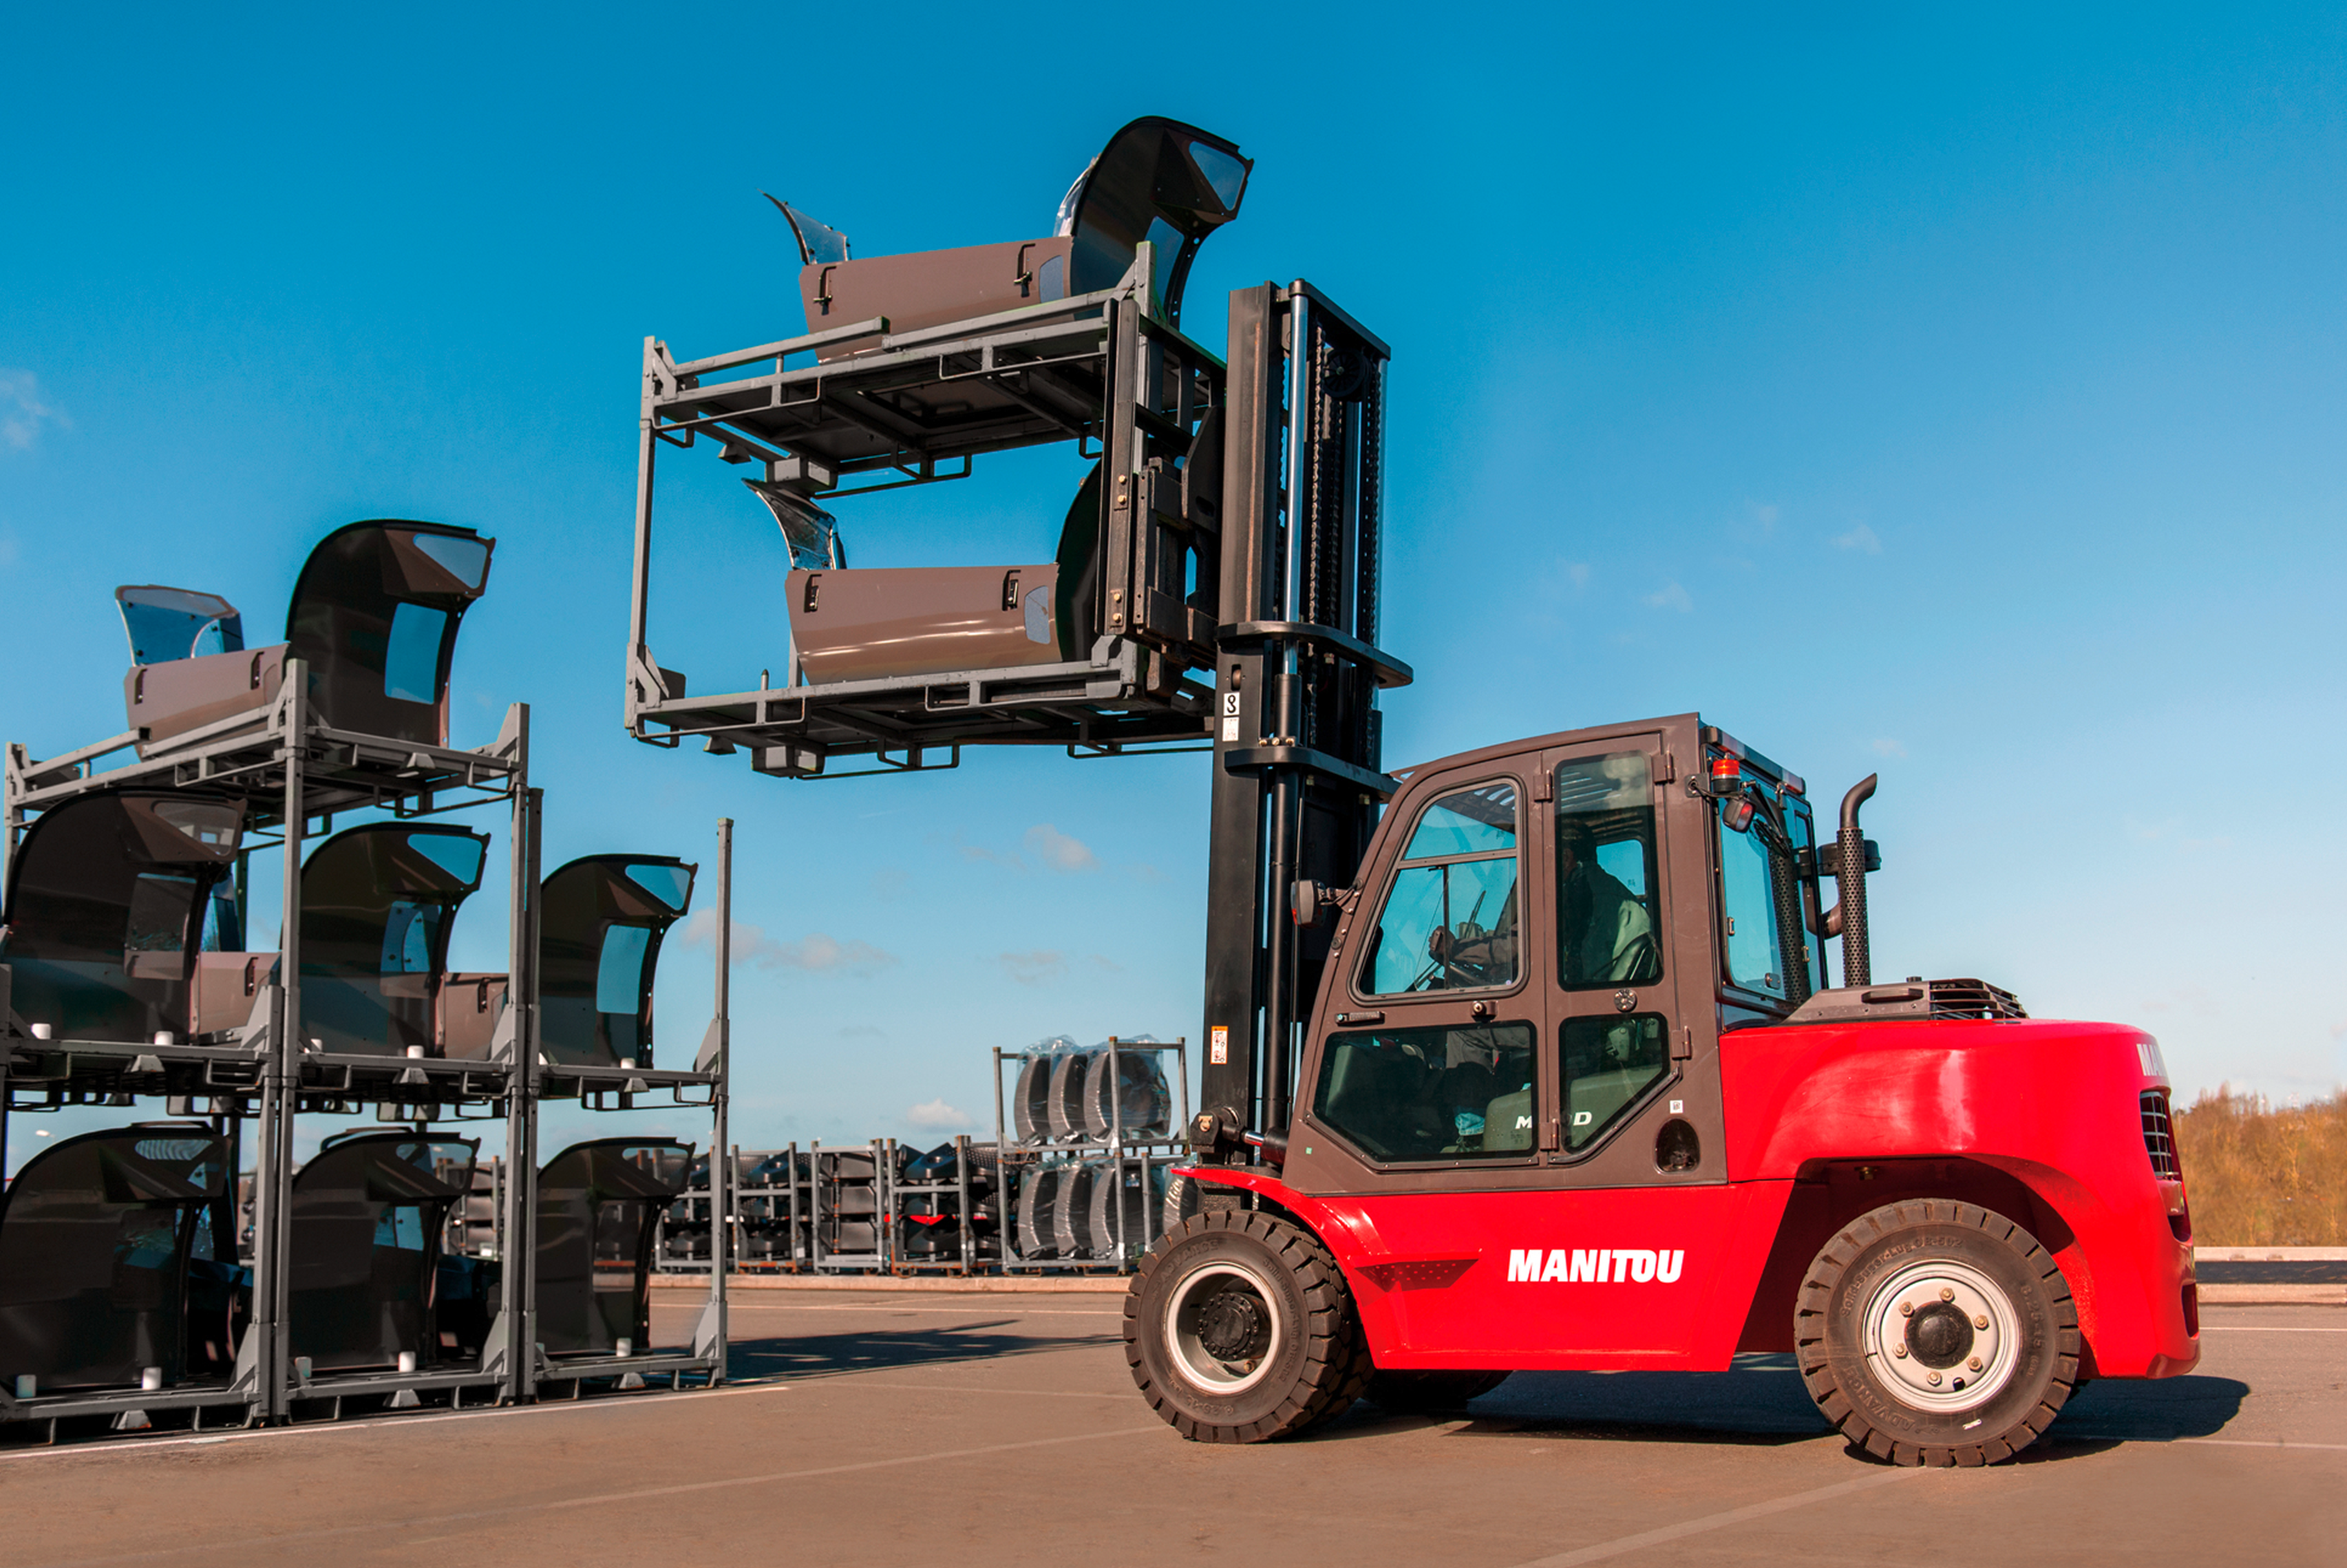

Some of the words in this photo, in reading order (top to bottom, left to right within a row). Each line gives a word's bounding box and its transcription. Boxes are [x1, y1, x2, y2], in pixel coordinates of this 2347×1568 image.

[1160, 1238, 1220, 1283] ADVANCE
[1507, 1249, 1685, 1284] MANITOU
[1843, 1365, 1916, 1432] ADVANCE
